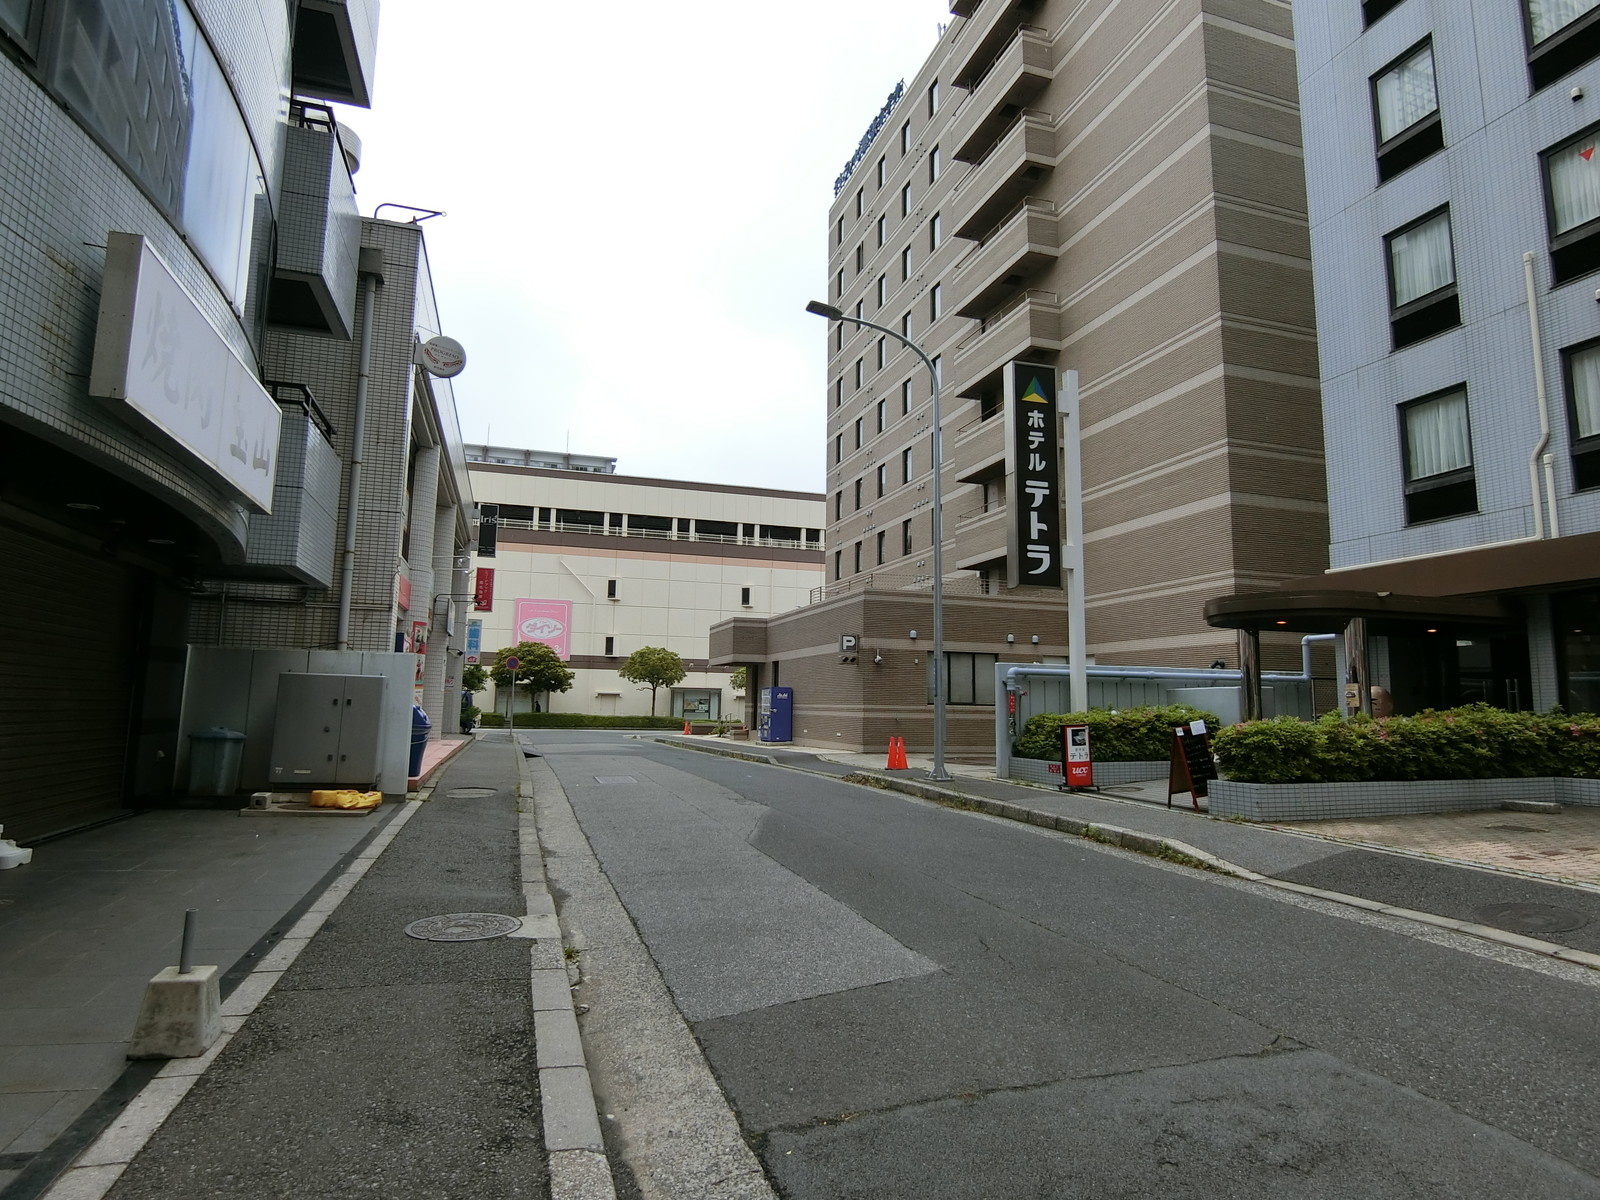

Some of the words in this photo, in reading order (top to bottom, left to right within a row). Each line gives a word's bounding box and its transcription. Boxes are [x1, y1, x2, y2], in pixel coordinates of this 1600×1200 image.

[1027, 409, 1047, 472] ホテル
[1024, 479, 1051, 575] テトラ
[467, 628, 480, 650] 歯科
[842, 636, 856, 650] P
[1069, 751, 1089, 760] テトラ
